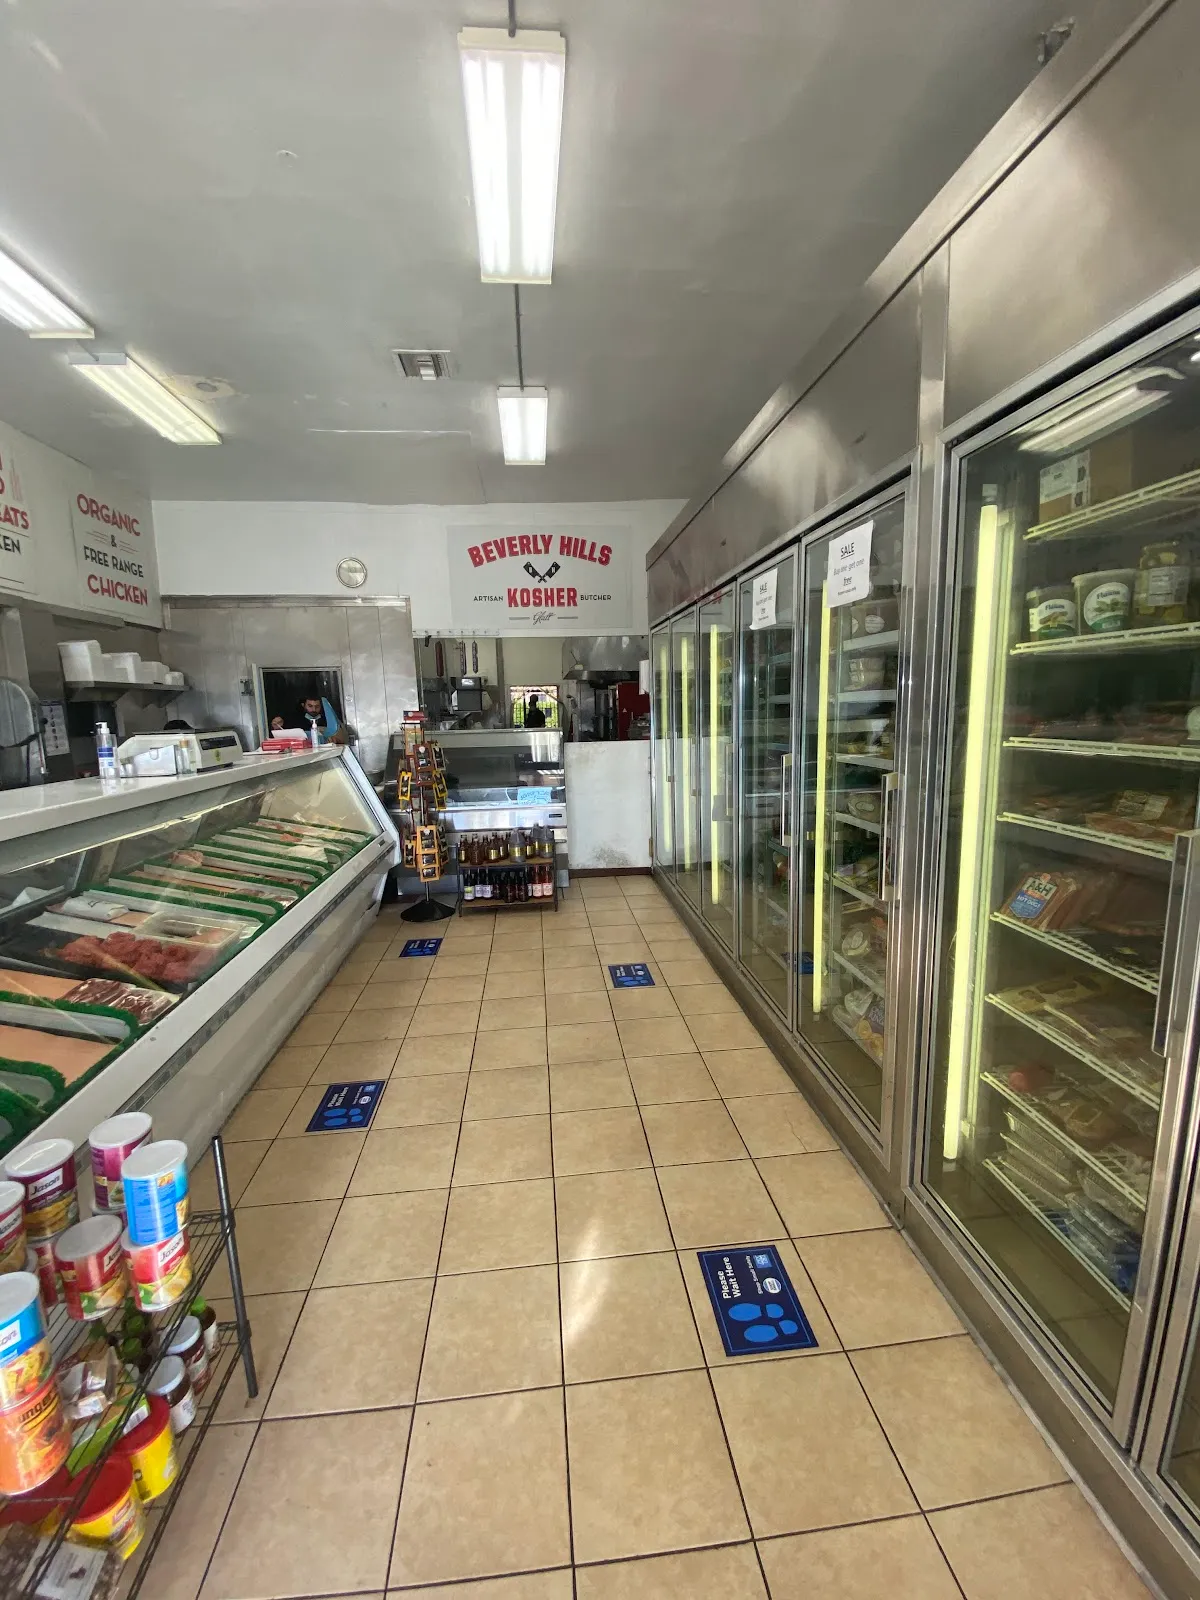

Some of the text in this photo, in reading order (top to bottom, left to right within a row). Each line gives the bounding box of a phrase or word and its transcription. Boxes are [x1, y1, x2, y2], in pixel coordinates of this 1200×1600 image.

[76, 493, 142, 537] ORGANIC
[110, 534, 118, 548] &
[467, 534, 613, 568] BEVERLY HILLS
[840, 541, 855, 558] SALE
[83, 545, 144, 578] FREE RANGE
[87, 573, 149, 606] CHICKEN
[507, 587, 578, 608] KOSHER
[30, 1174, 61, 1196] Jason
[717, 1270, 732, 1299] Please
[723, 1256, 742, 1298] Wait Here
[0, 1329, 18, 1347] on
